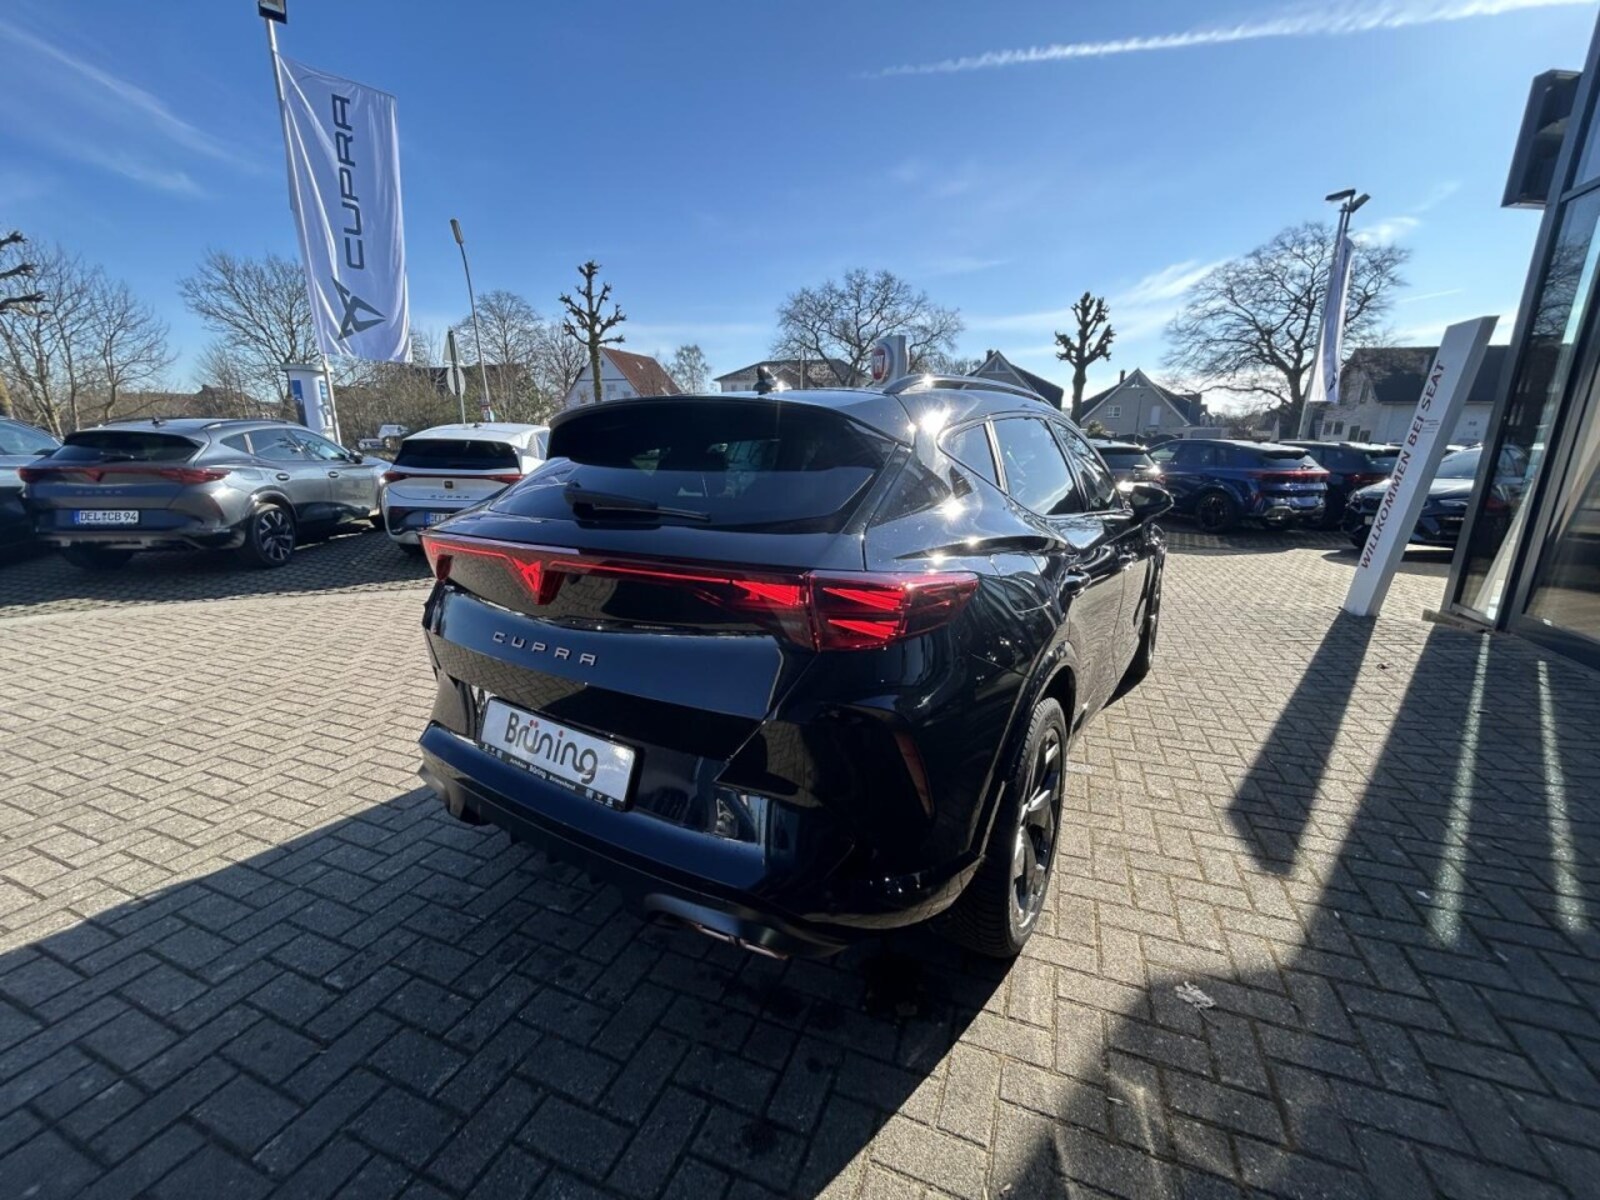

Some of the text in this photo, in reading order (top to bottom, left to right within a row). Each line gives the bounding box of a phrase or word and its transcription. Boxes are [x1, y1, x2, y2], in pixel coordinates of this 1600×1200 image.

[331, 93, 365, 271] CUPRA
[1360, 451, 1411, 569] WILLKOMMEN
[1407, 415, 1425, 447] BEI
[1421, 359, 1446, 412] SEAT
[123, 511, 137, 521] 94
[492, 631, 598, 666] CUPRA
[504, 711, 599, 785] Brüning
